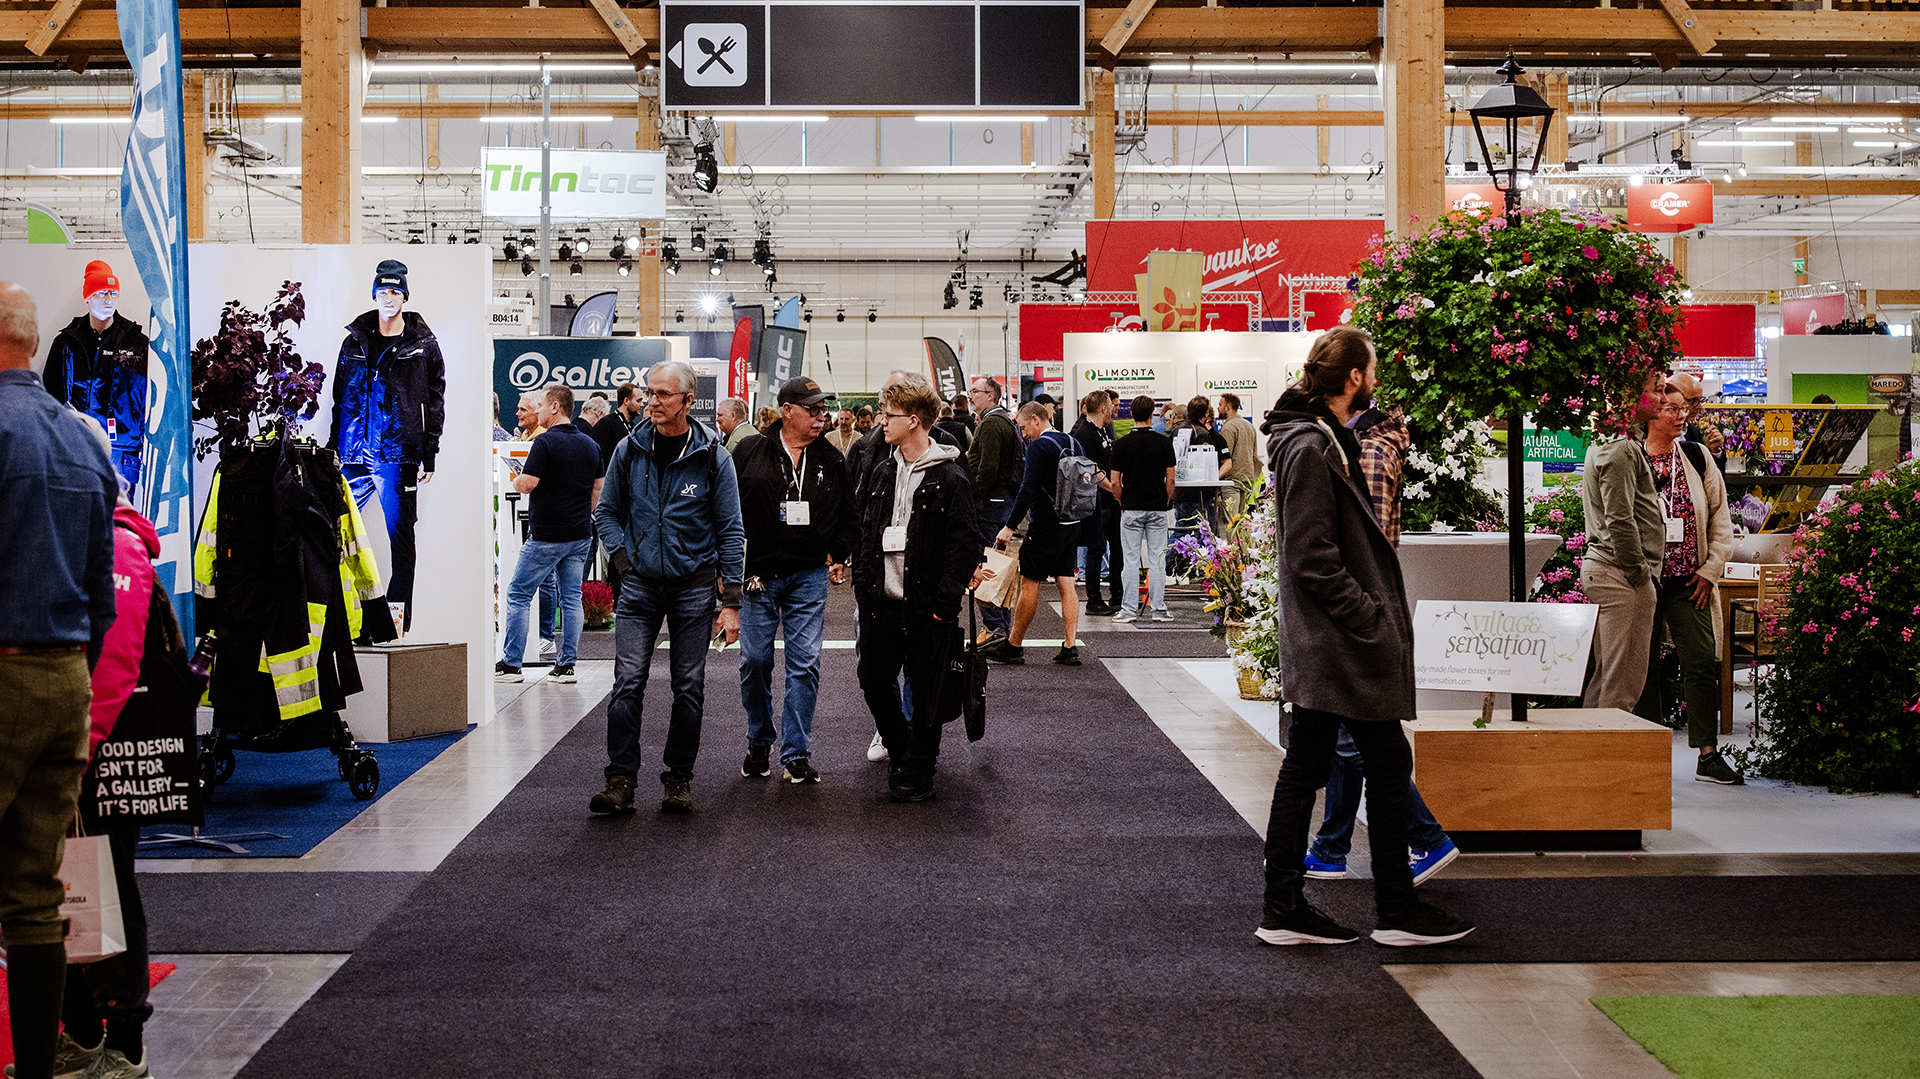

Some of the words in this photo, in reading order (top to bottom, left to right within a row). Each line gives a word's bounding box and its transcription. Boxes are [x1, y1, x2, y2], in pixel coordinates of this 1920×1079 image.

[487, 165, 655, 194] Tinntac
[1650, 199, 1688, 209] CRAMER
[492, 314, 519, 323] B04:14
[551, 359, 649, 387] saltex
[1769, 437, 1789, 448] JUB
[1527, 448, 1577, 458] ARTIFICIAL
[1729, 505, 1762, 516] lland.nl
[1445, 634, 1546, 664] sensation
[1414, 665, 1446, 674] ady-made
[1447, 665, 1468, 673] flower
[1487, 667, 1497, 675] for
[98, 742, 135, 758] OOD
[136, 738, 185, 757] DESIGN
[137, 758, 165, 776] FOR
[96, 782, 109, 798] A
[111, 776, 172, 796] GALLERY
[98, 799, 130, 817] IT'S
[131, 798, 159, 815] FOR
[159, 795, 189, 812] LIFE
